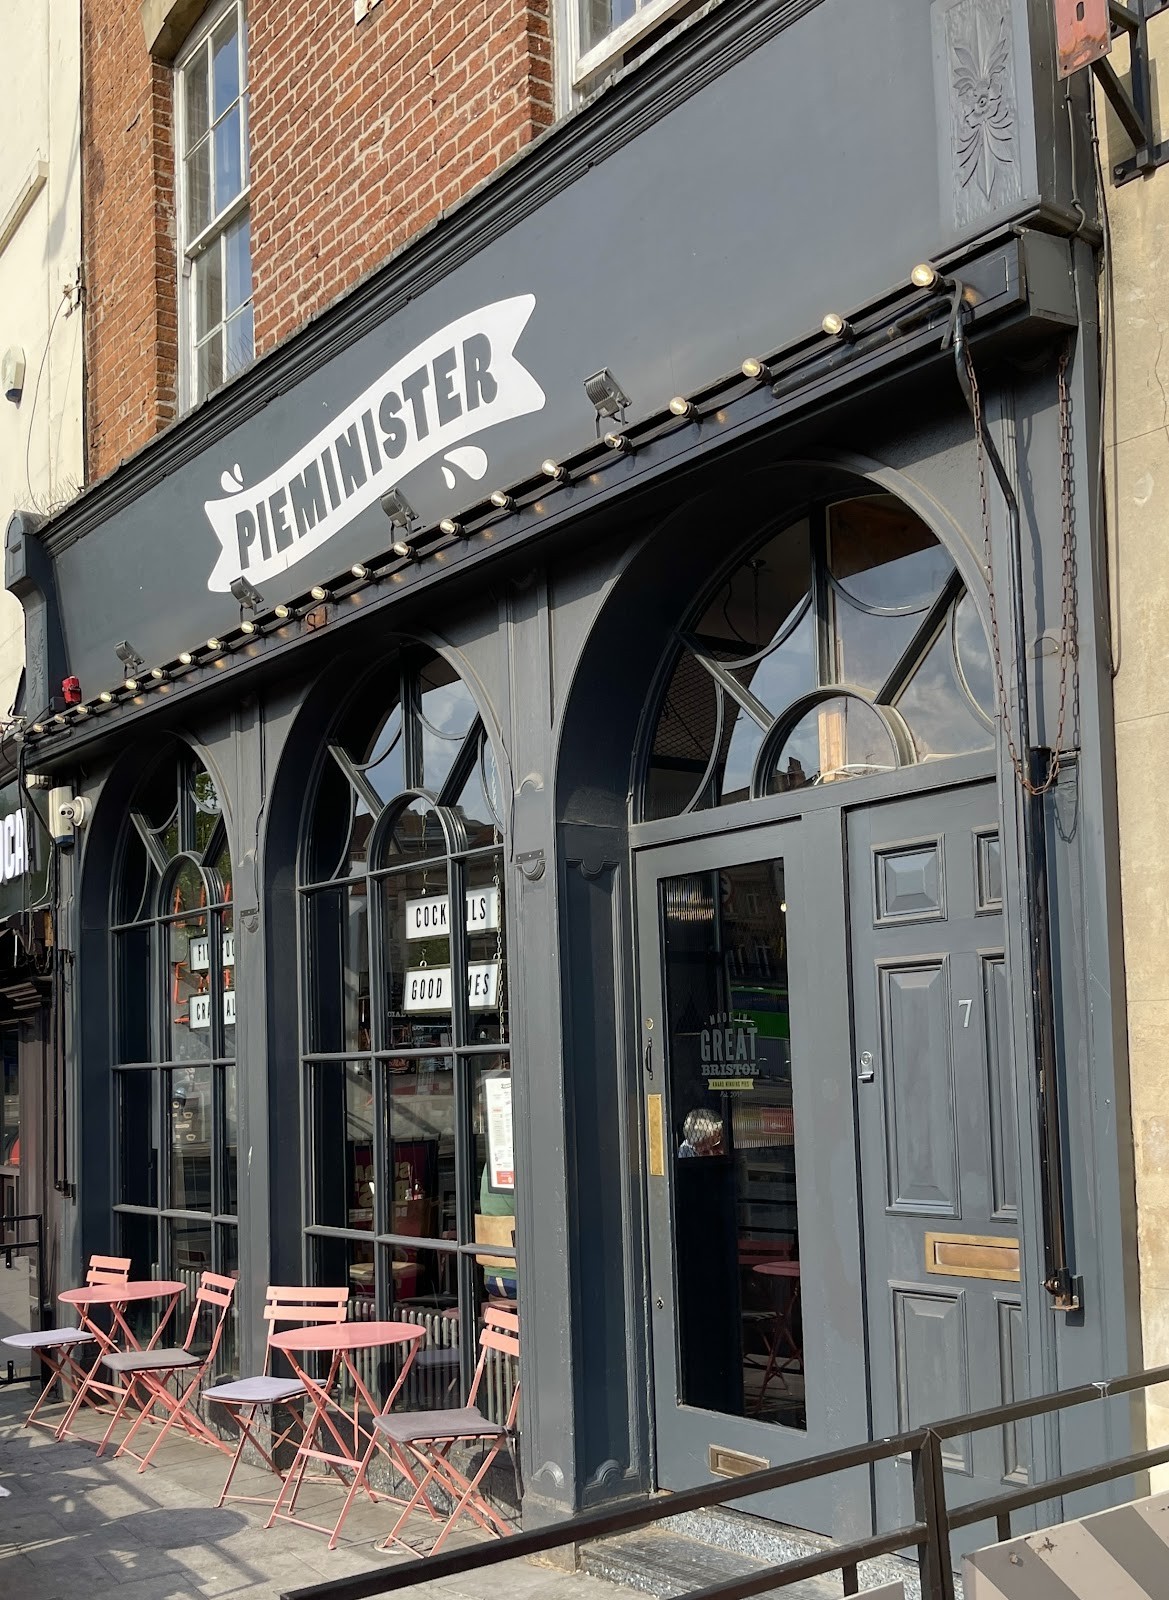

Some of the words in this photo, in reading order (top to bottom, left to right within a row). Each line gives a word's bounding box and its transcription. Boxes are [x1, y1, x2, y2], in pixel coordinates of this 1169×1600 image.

[235, 333, 498, 570] PIEMINISTER
[411, 977, 443, 1001] GOOD
[709, 1012, 733, 1025] MADE
[959, 999, 972, 1028] 7
[700, 1027, 758, 1062] GREAT
[701, 1063, 760, 1076] BRISTOL
